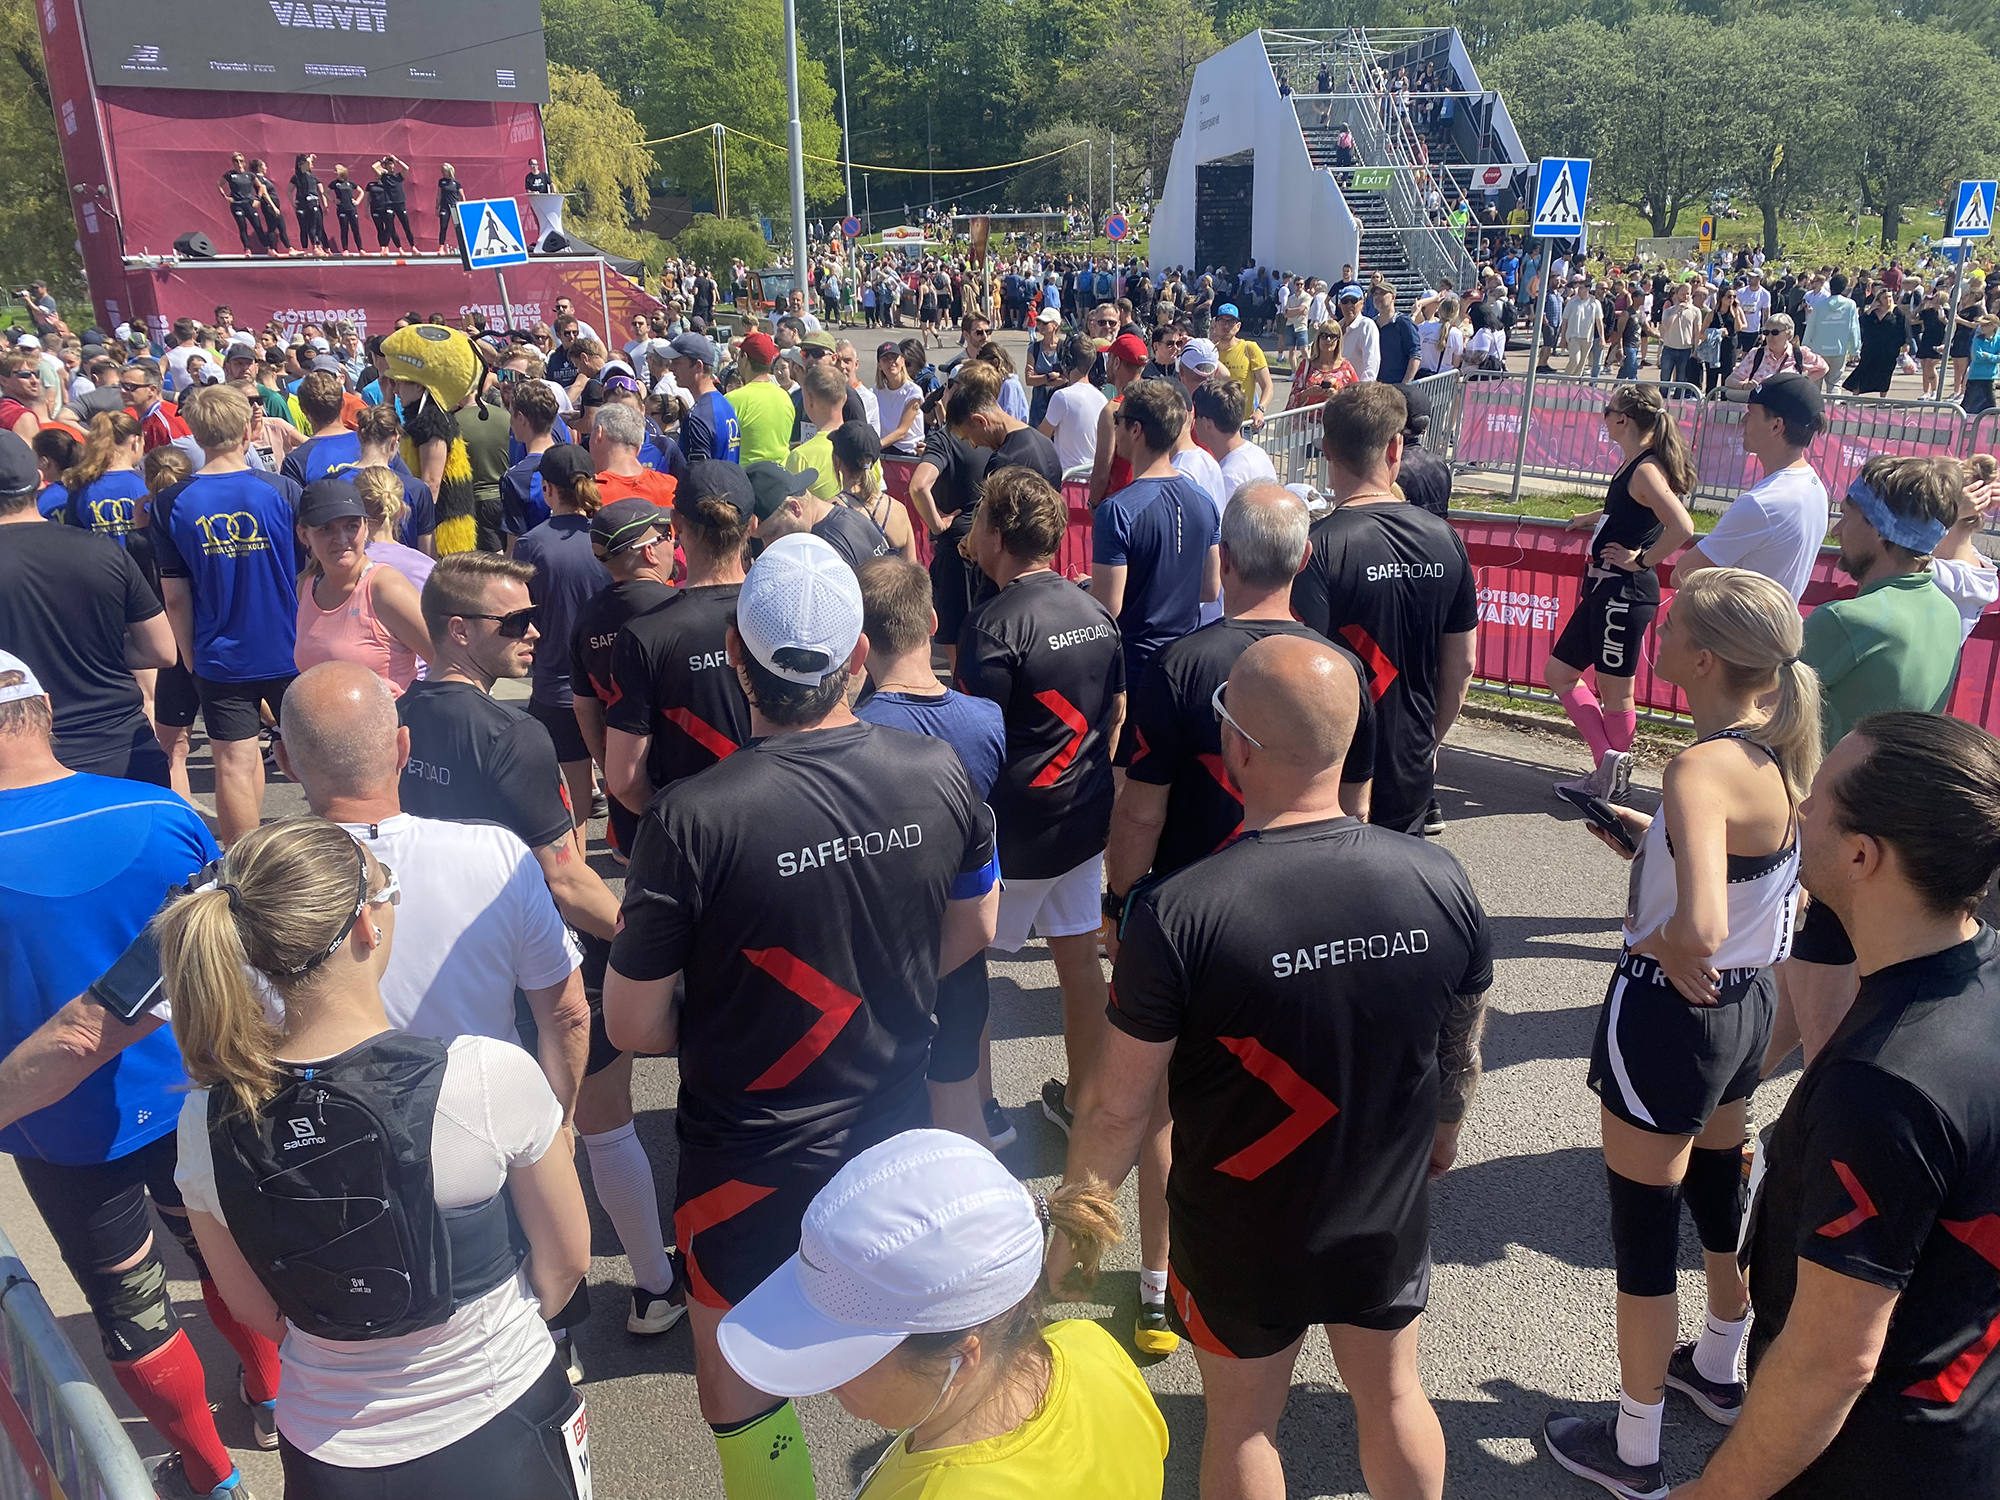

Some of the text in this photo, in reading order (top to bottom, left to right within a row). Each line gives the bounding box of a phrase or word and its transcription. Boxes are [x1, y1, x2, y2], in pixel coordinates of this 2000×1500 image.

[269, 1, 387, 32] VARVET
[1362, 176, 1384, 185] EXIT
[273, 308, 367, 323] GÖTEBORGS
[195, 511, 259, 546] 100
[1366, 563, 1444, 581] SAFEROAD
[590, 632, 617, 649] SAF
[1048, 624, 1109, 650] SAFEROAD
[776, 824, 922, 877] SAFEROAD
[328, 936, 343, 953] stc
[1272, 929, 1429, 978] SAFEROAD
